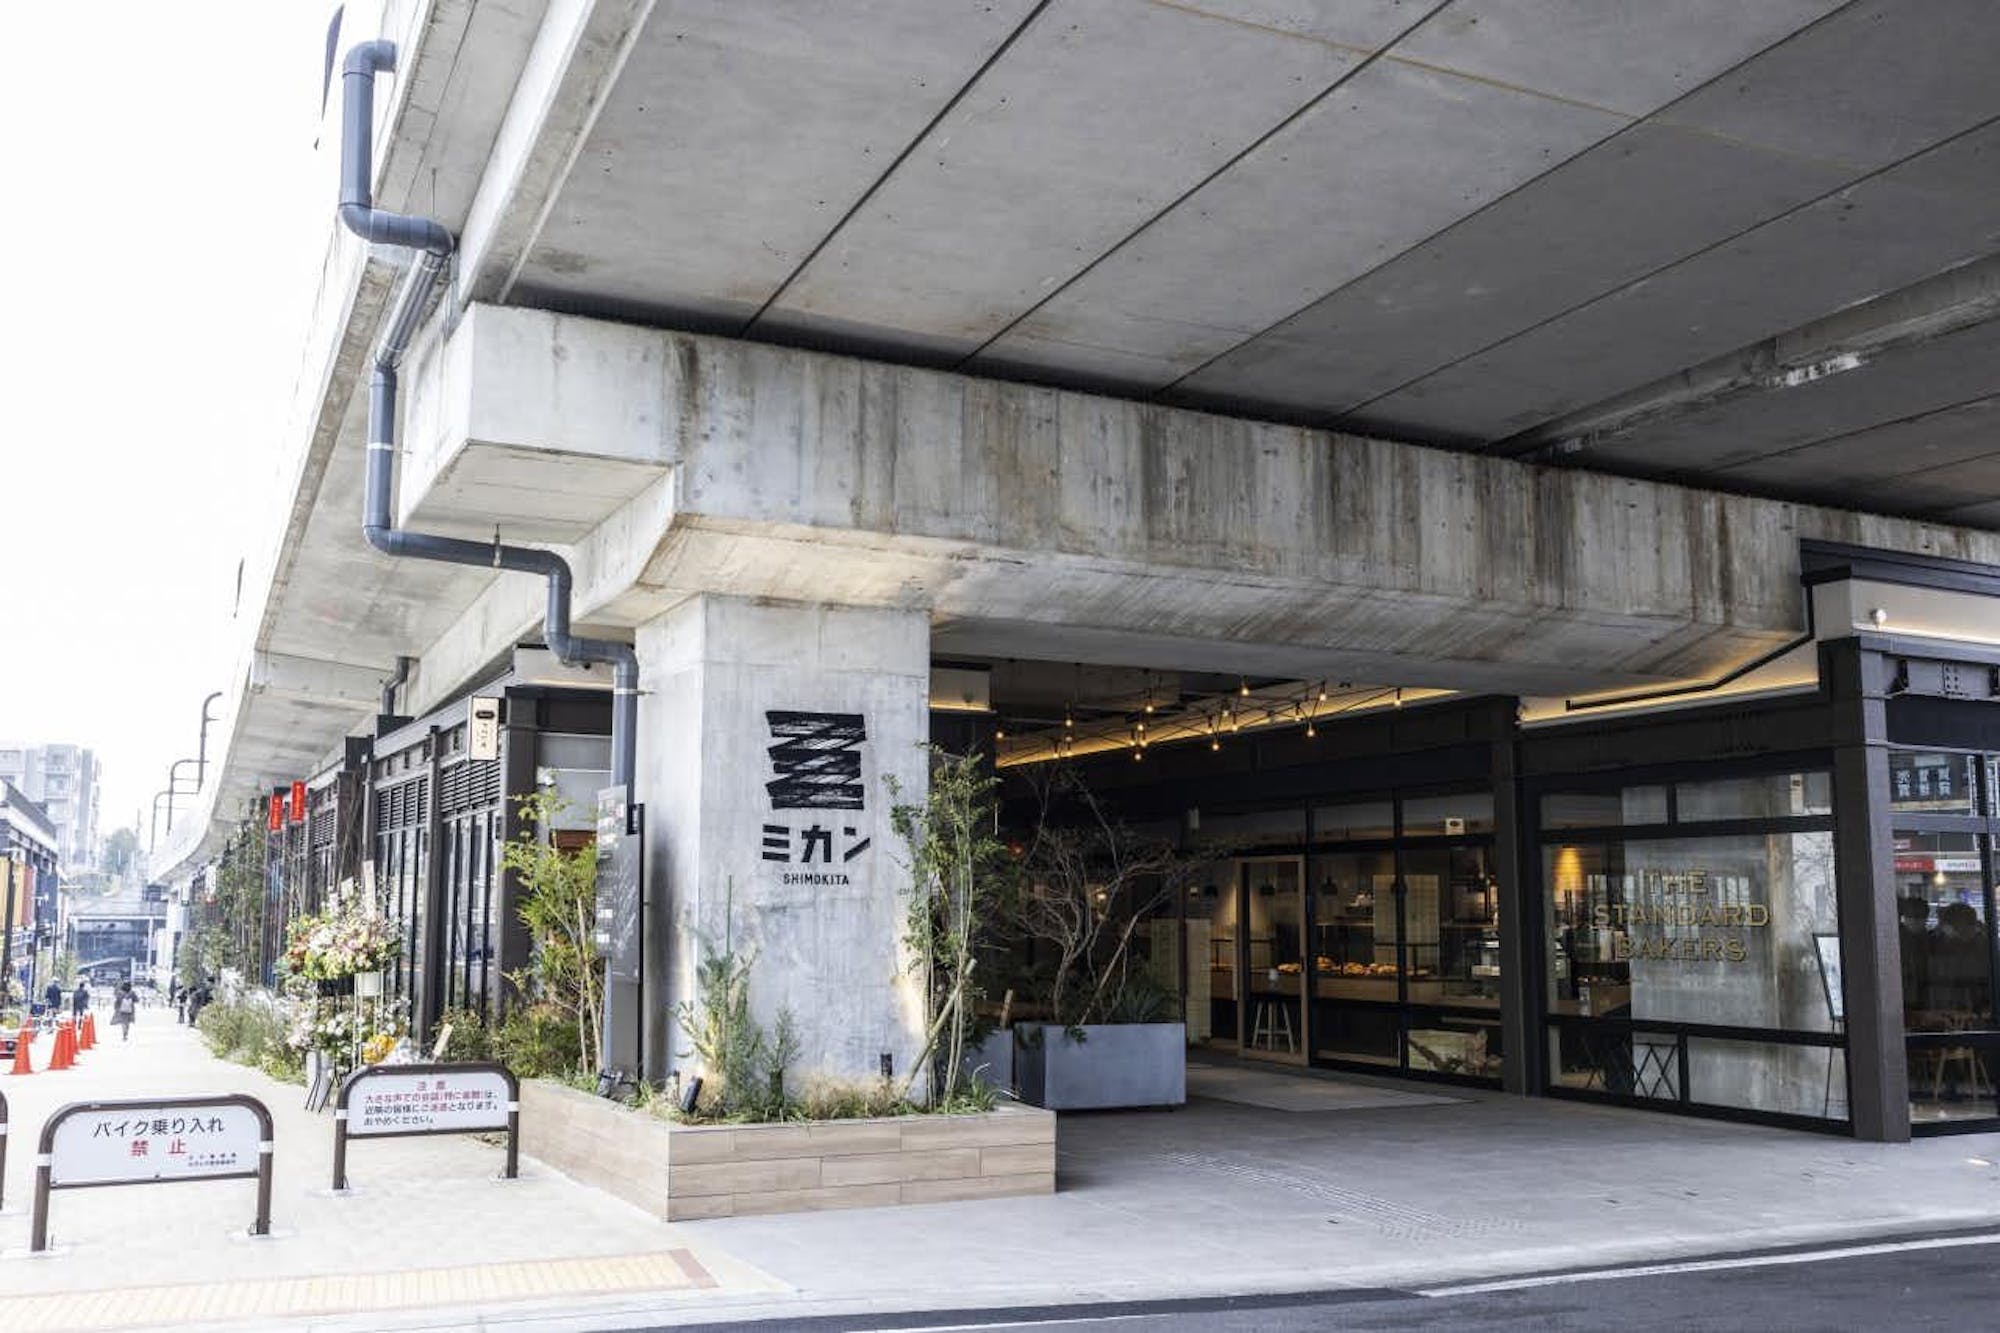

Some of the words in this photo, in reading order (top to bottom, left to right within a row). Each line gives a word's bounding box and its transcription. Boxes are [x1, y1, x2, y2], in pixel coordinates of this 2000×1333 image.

[762, 824, 871, 863] ミカン
[783, 873, 849, 885] SHIMOKITA
[1647, 870, 1709, 896] THE
[1593, 902, 1771, 927] STANDARD
[1615, 936, 1748, 962] BAKERS
[93, 1116, 225, 1138] バイク乗り入れ
